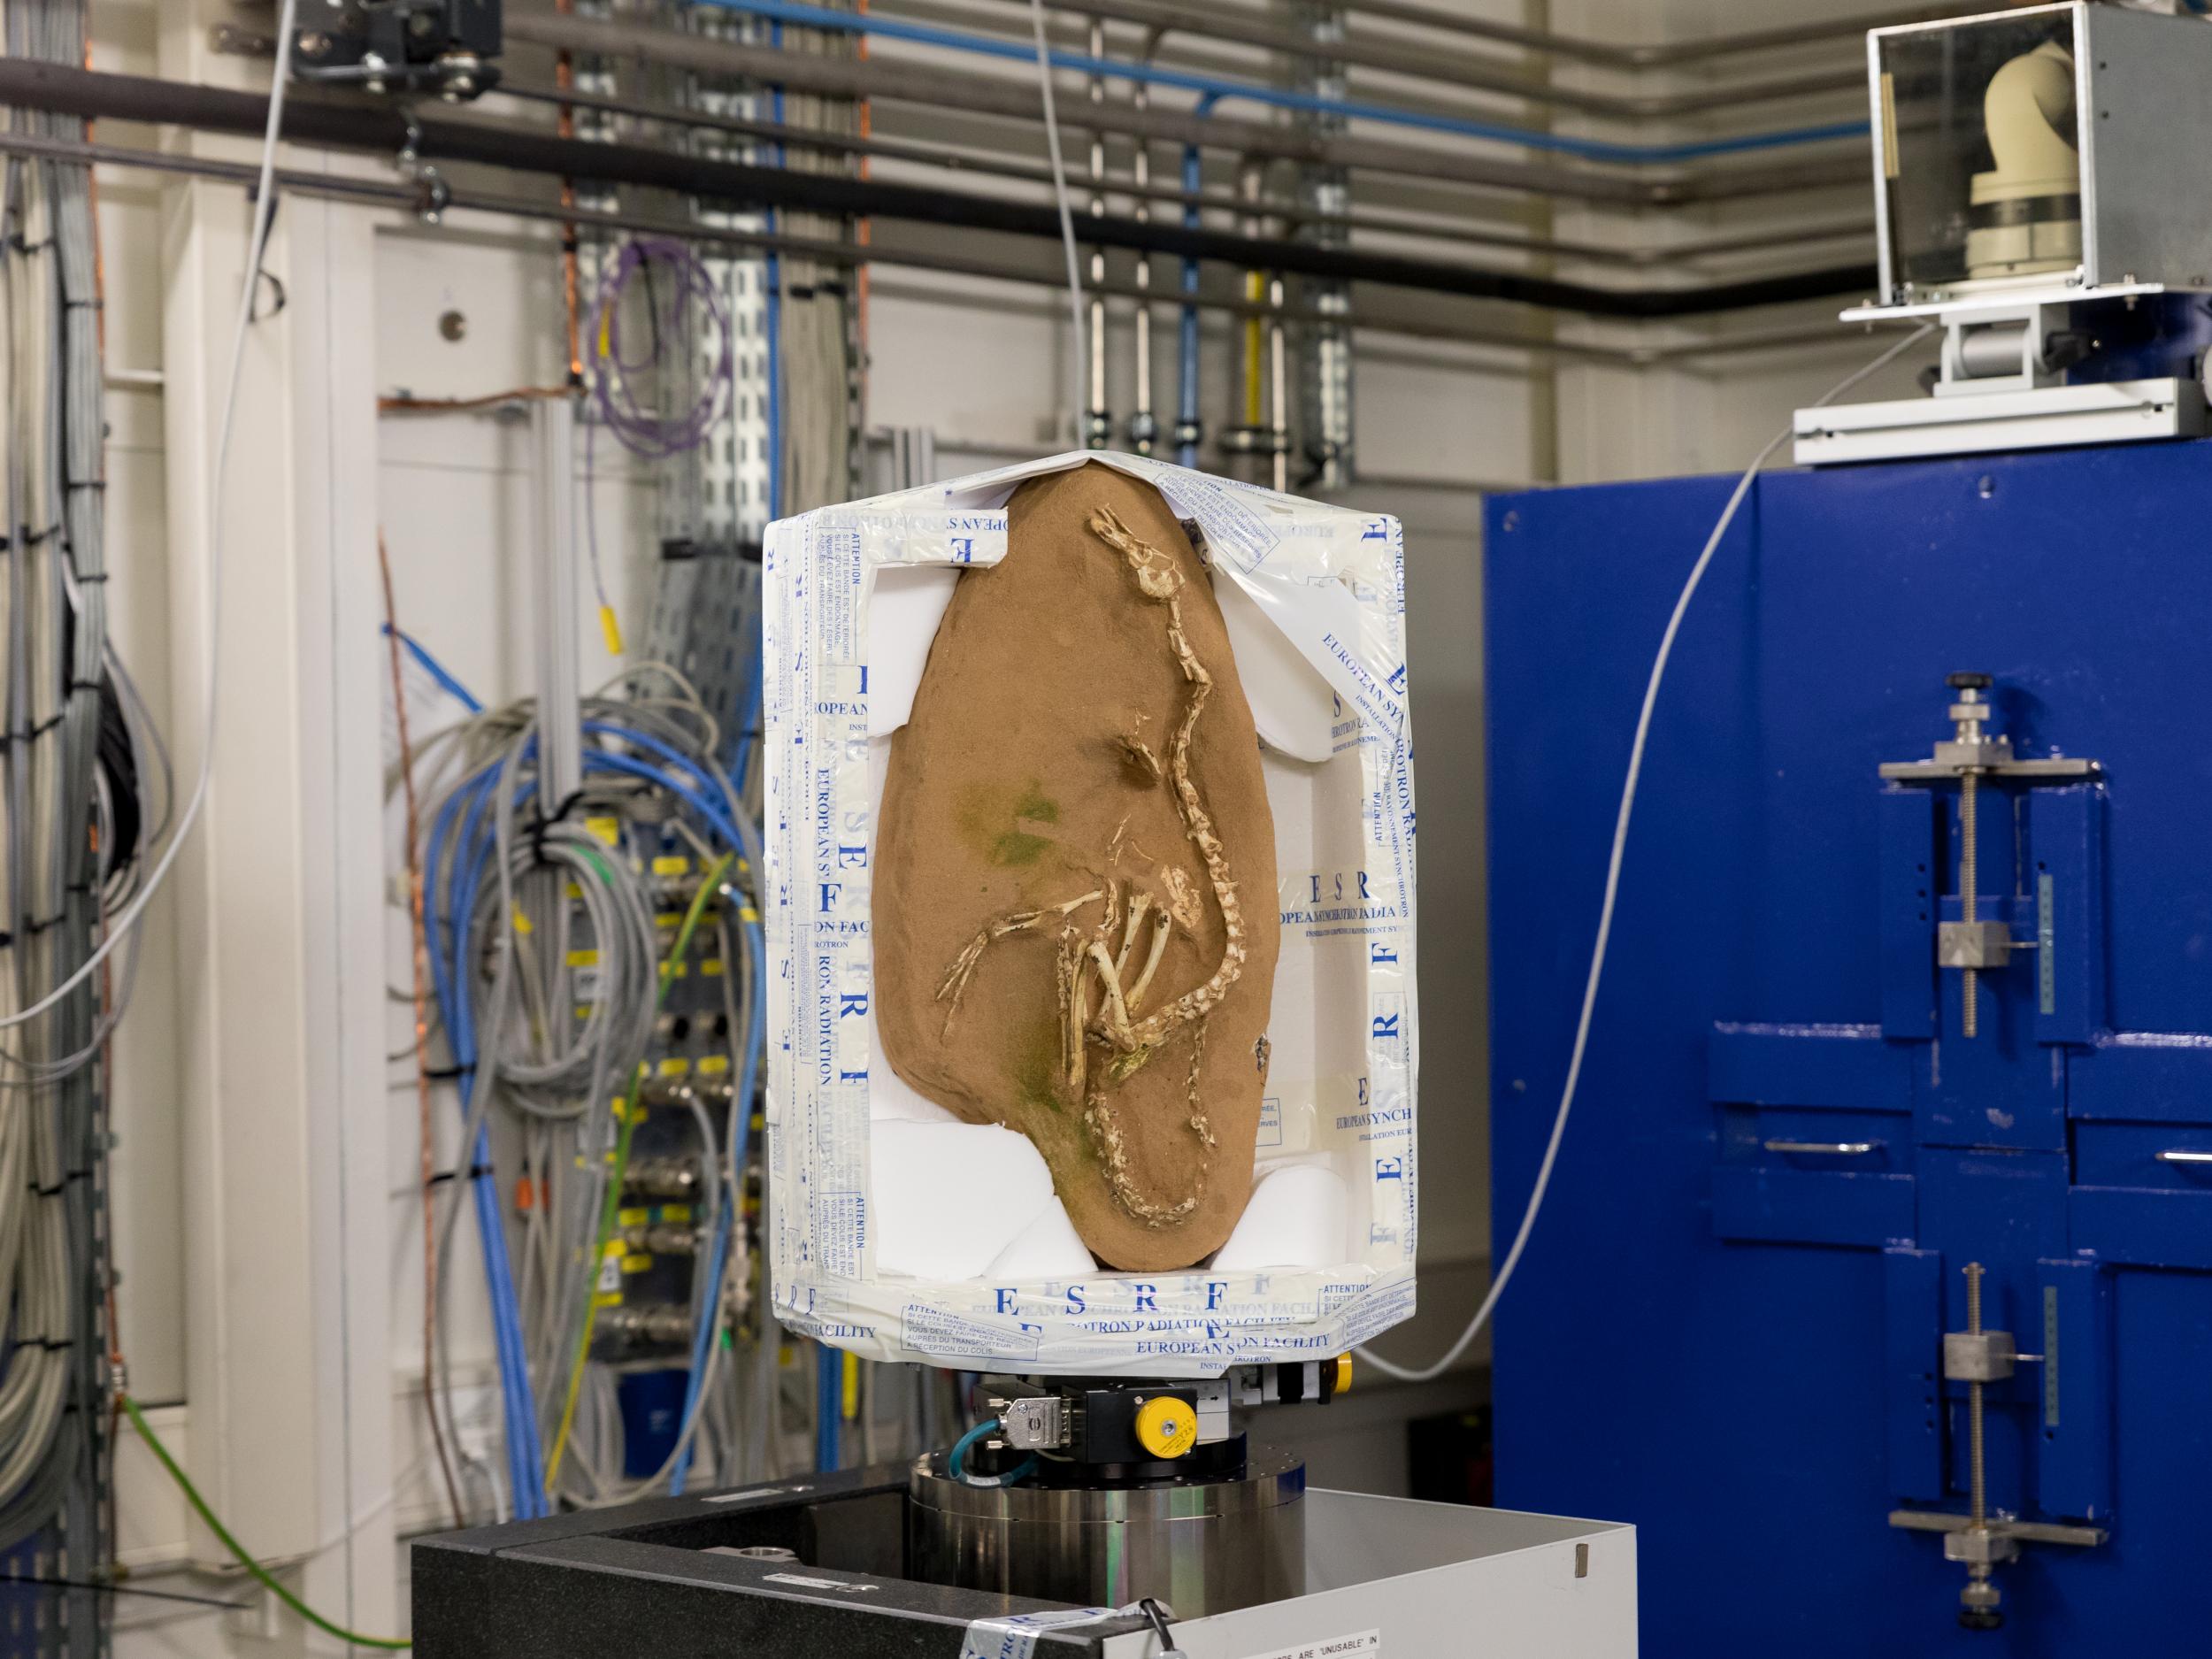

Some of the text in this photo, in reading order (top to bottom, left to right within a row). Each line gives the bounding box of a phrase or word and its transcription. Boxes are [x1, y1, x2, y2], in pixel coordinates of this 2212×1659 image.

[851, 533, 861, 585] ATTENTION
[817, 768, 830, 858] EUROPEAN
[838, 842, 867, 870] E
[818, 883, 842, 913] F
[1310, 871, 1371, 903] E S R
[840, 990, 869, 1020] R
[819, 995, 832, 1086] RADIATION
[1372, 1012, 1399, 1041] R
[1375, 1156, 1402, 1183] E
[856, 1196, 864, 1249] ATTENTION
[994, 1287, 1019, 1316] E
[1065, 1285, 1086, 1315] S
[1133, 1284, 1158, 1312] R
[1204, 1282, 1229, 1310] F
[929, 1327, 954, 1336] DEVEZ
[951, 1337, 1012, 1349] TRANSPORTEUR
[972, 1347, 994, 1356] COLIS
[1137, 1341, 1223, 1355] EUROPEAN
[1369, 1635, 1378, 1645] IN
